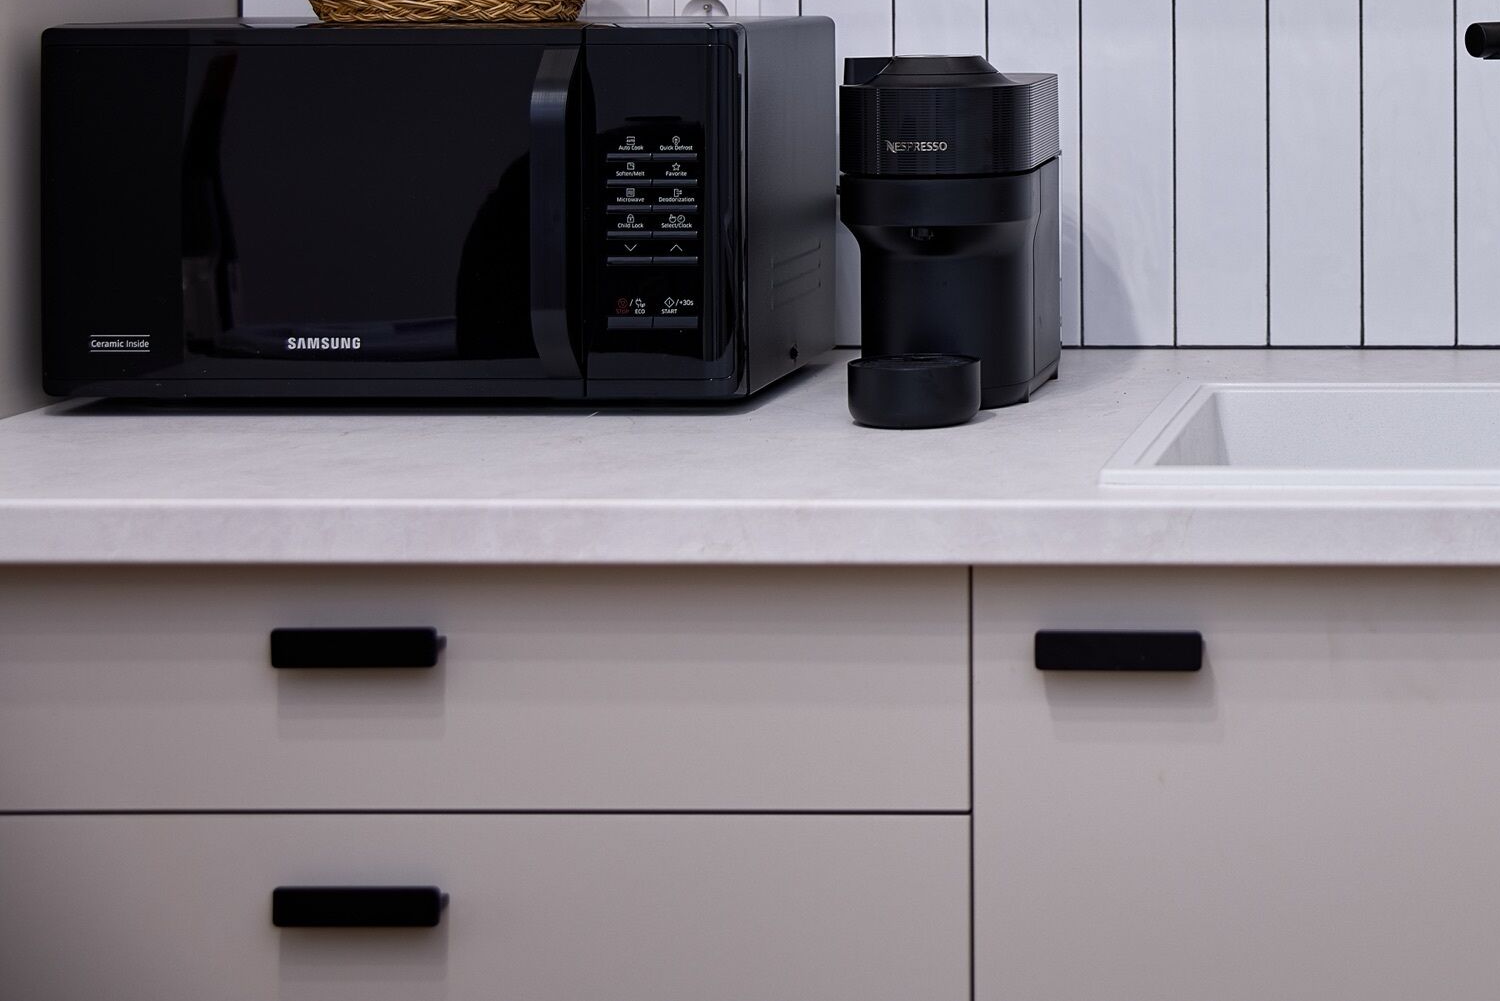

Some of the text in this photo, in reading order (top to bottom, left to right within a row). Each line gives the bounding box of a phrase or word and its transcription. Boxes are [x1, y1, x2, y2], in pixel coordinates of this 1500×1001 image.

[885, 140, 948, 153] NESPRESSO
[91, 339, 150, 348] Ceramic Inside
[287, 337, 361, 350] SAMSUNG
